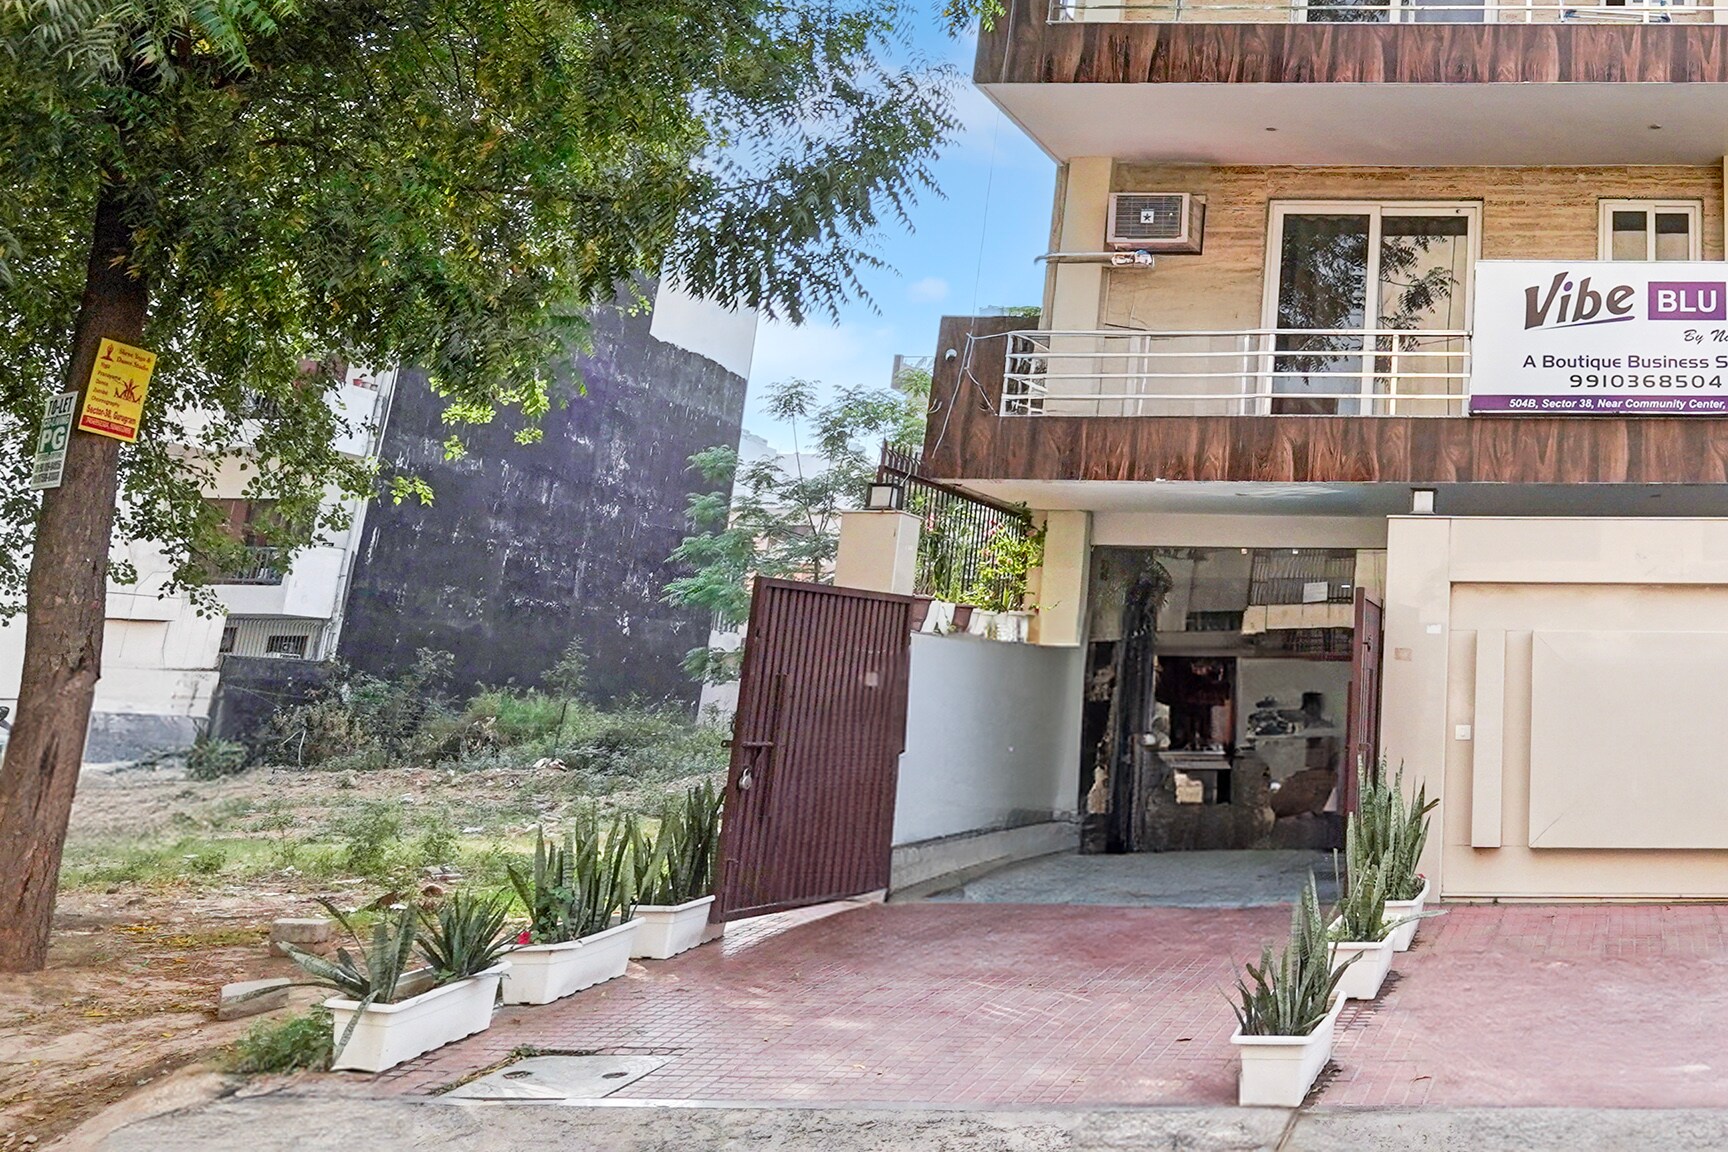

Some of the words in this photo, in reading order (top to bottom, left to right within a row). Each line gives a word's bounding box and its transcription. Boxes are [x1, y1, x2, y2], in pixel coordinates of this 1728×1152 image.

[1524, 271, 1635, 330] Vibe
[1657, 289, 1717, 313] BLU
[1683, 328, 1704, 345] By
[1522, 354, 1536, 368] A
[1542, 354, 1622, 371] Boutique
[1628, 355, 1709, 368] Business
[1569, 374, 1722, 388] 9910368504
[47, 396, 73, 416] TO-LET
[1509, 398, 1539, 409] 504B,
[1541, 398, 1577, 408] Sector
[1579, 398, 1595, 409] 38,
[1597, 398, 1623, 408] Near
[1624, 398, 1686, 410] Community
[1688, 398, 1726, 410] Center,
[39, 426, 66, 452] PG
